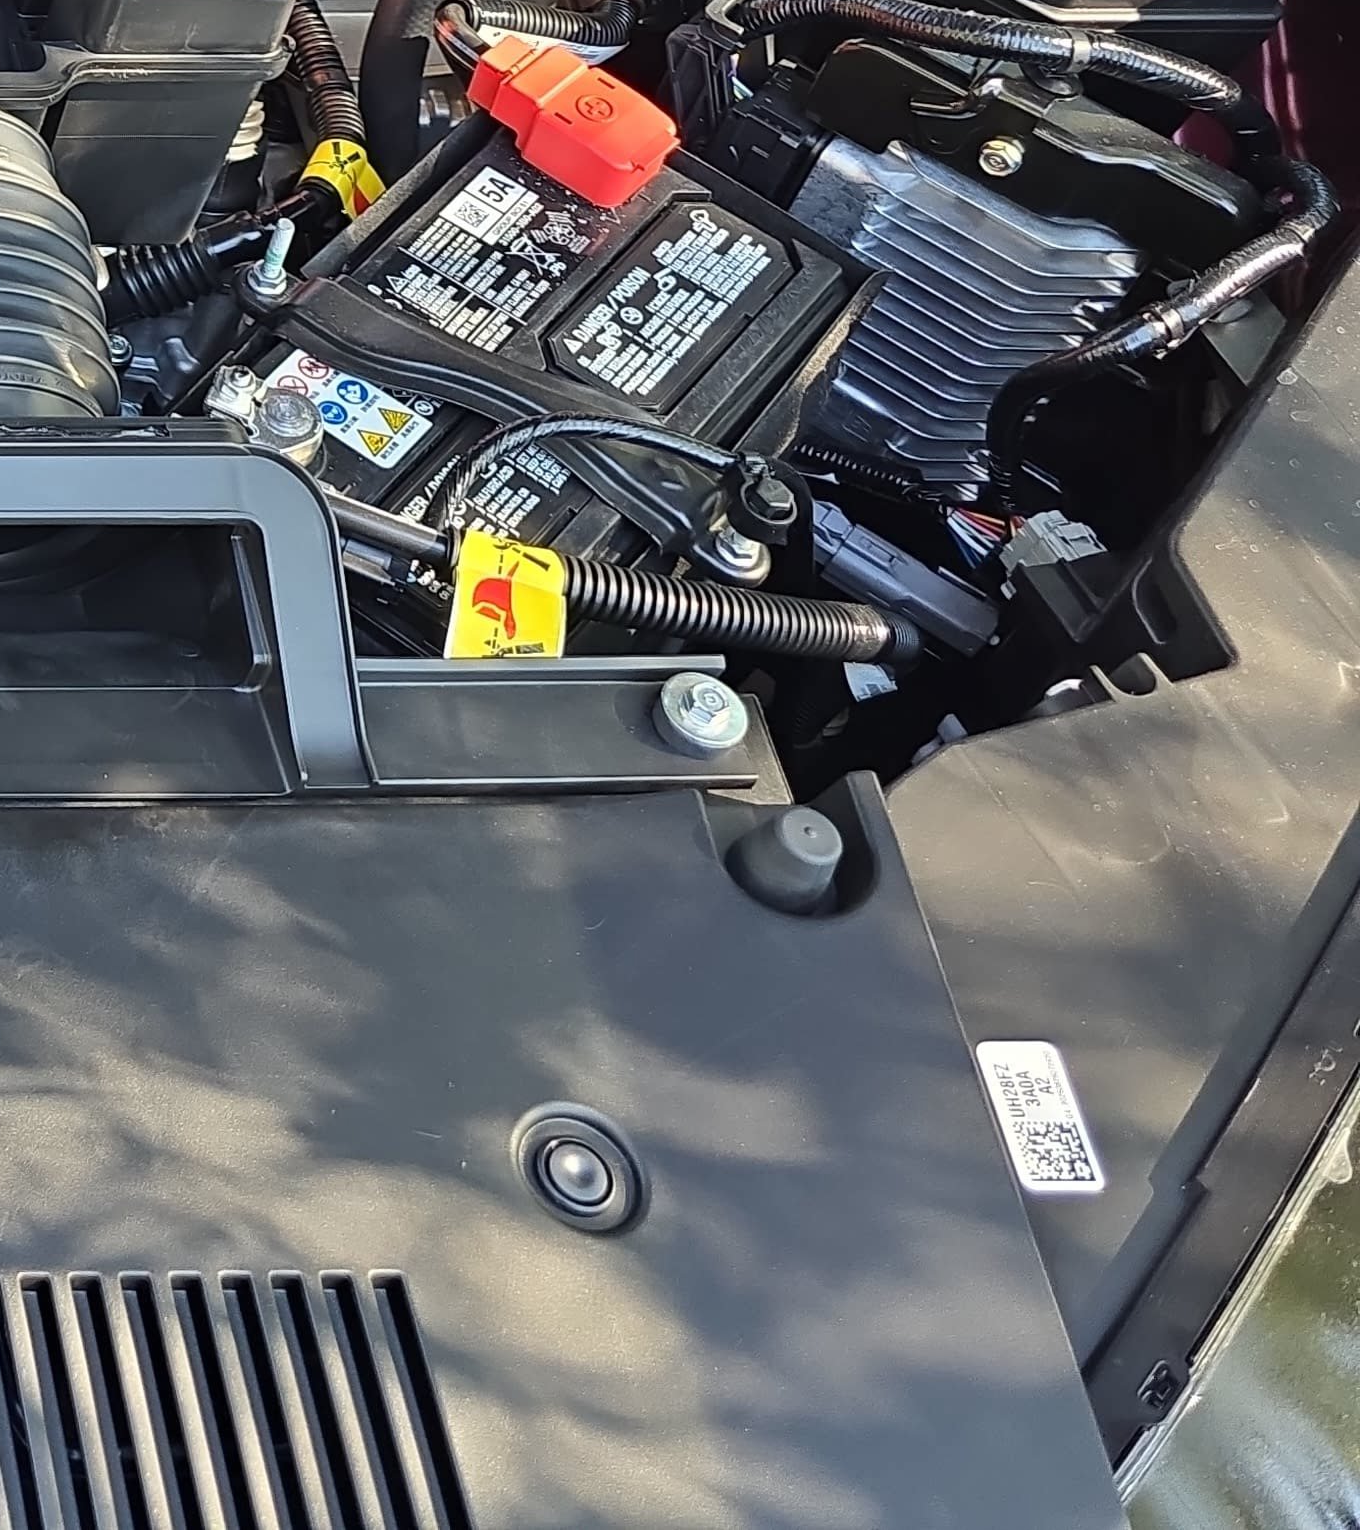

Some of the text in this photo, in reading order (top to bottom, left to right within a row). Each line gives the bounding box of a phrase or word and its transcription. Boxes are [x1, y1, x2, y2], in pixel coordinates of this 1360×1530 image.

[479, 177, 515, 203] 5A
[993, 1063, 1026, 1118] UH28FZ
[1016, 1070, 1041, 1107] 3A0A
[1034, 1077, 1054, 1095] A2
